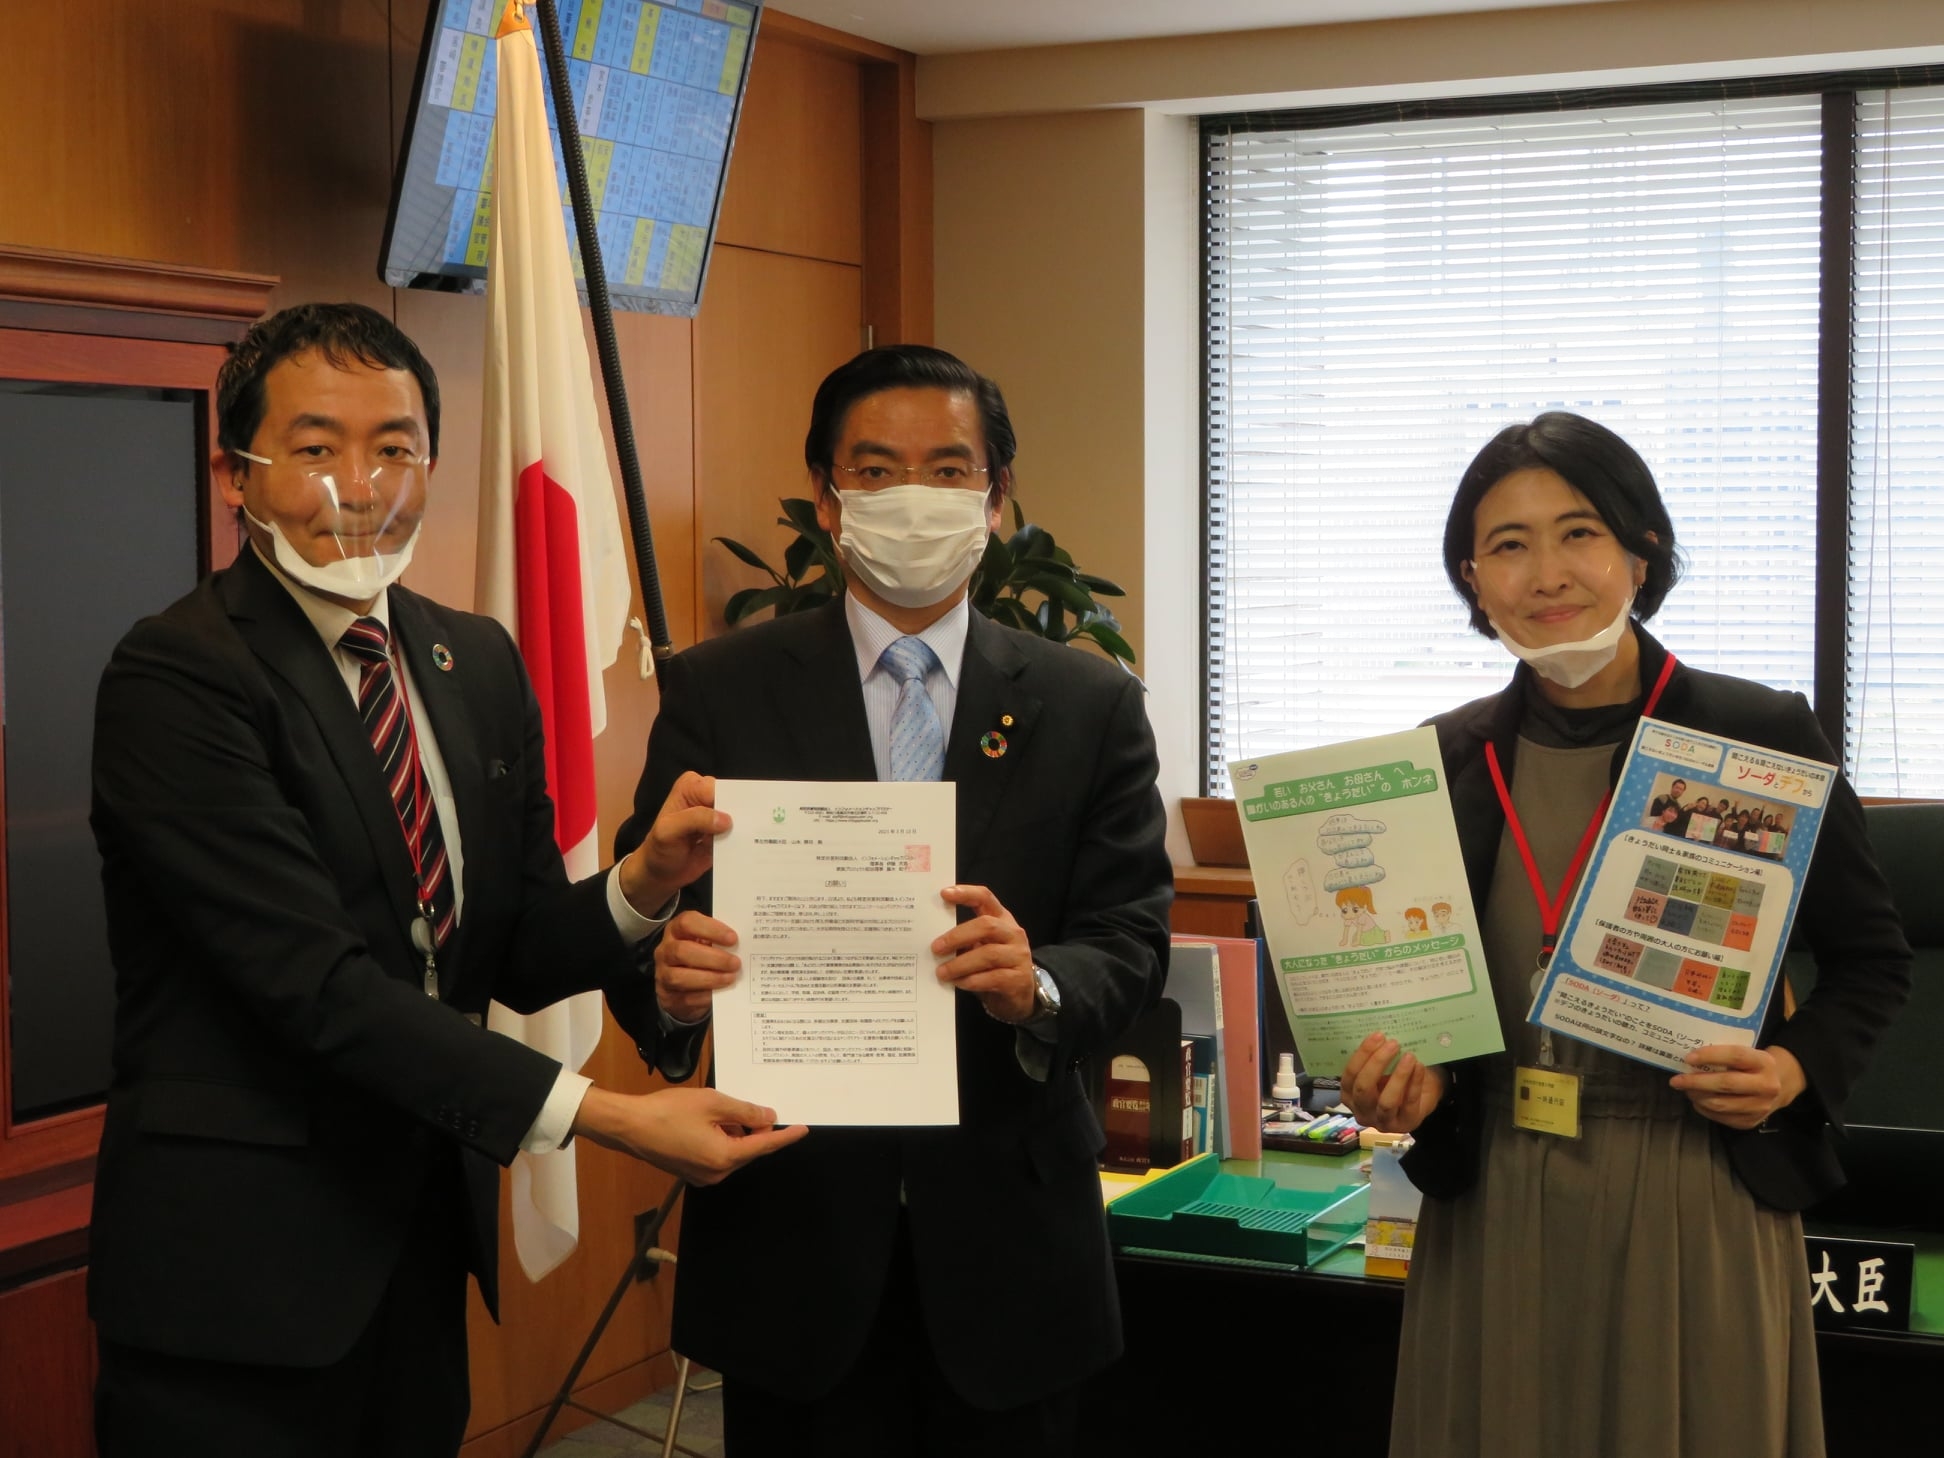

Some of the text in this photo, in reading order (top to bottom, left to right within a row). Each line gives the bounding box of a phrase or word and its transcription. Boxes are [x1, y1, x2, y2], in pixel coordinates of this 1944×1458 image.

[1665, 738, 1695, 754] SODA
[1273, 786, 1292, 798] 若い
[1299, 778, 1336, 794] お父さん
[1344, 770, 1385, 786] お母さん
[1402, 773, 1434, 790] ホンネ
[1282, 952, 1328, 970] 大人になった
[1384, 936, 1460, 959] からのメッセージ
[1811, 1250, 1890, 1314] 大臣
